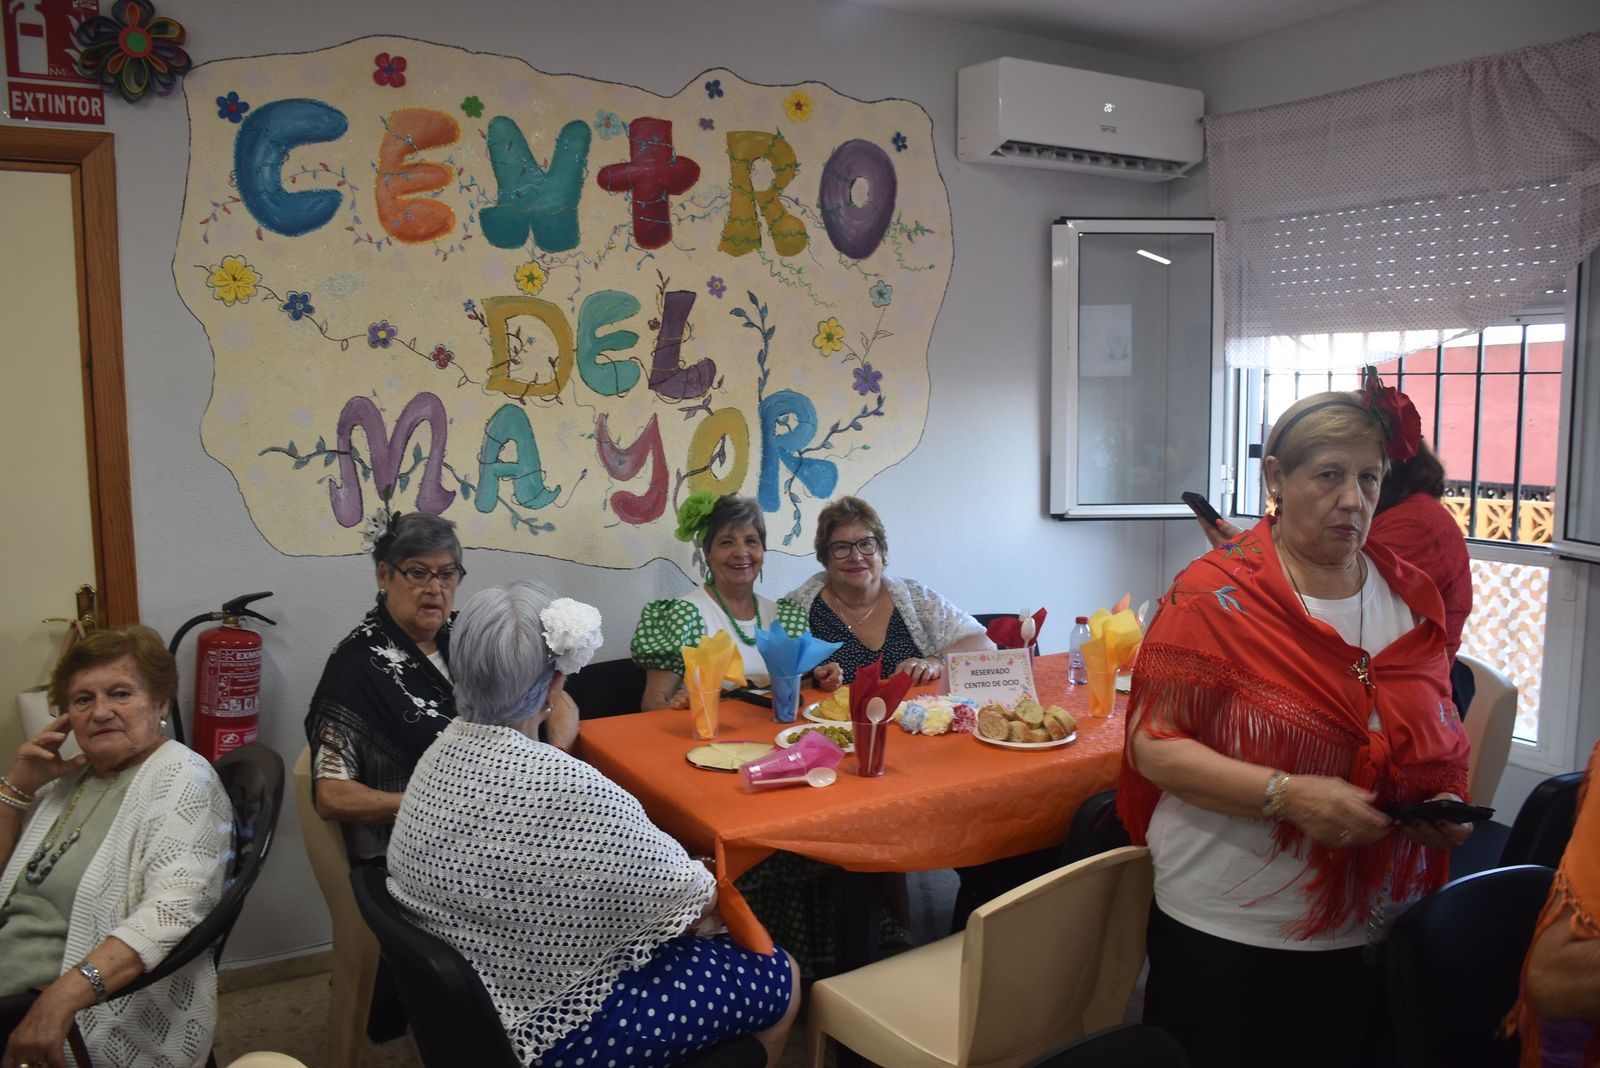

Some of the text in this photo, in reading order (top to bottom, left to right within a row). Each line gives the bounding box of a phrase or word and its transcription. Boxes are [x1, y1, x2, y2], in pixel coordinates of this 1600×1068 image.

[11, 91, 102, 117] EXTINTOR
[481, 290, 718, 401] DEL
[330, 391, 839, 527] MAYOR
[971, 667, 1010, 676] RESERVADO
[964, 681, 991, 689] CENTRO
